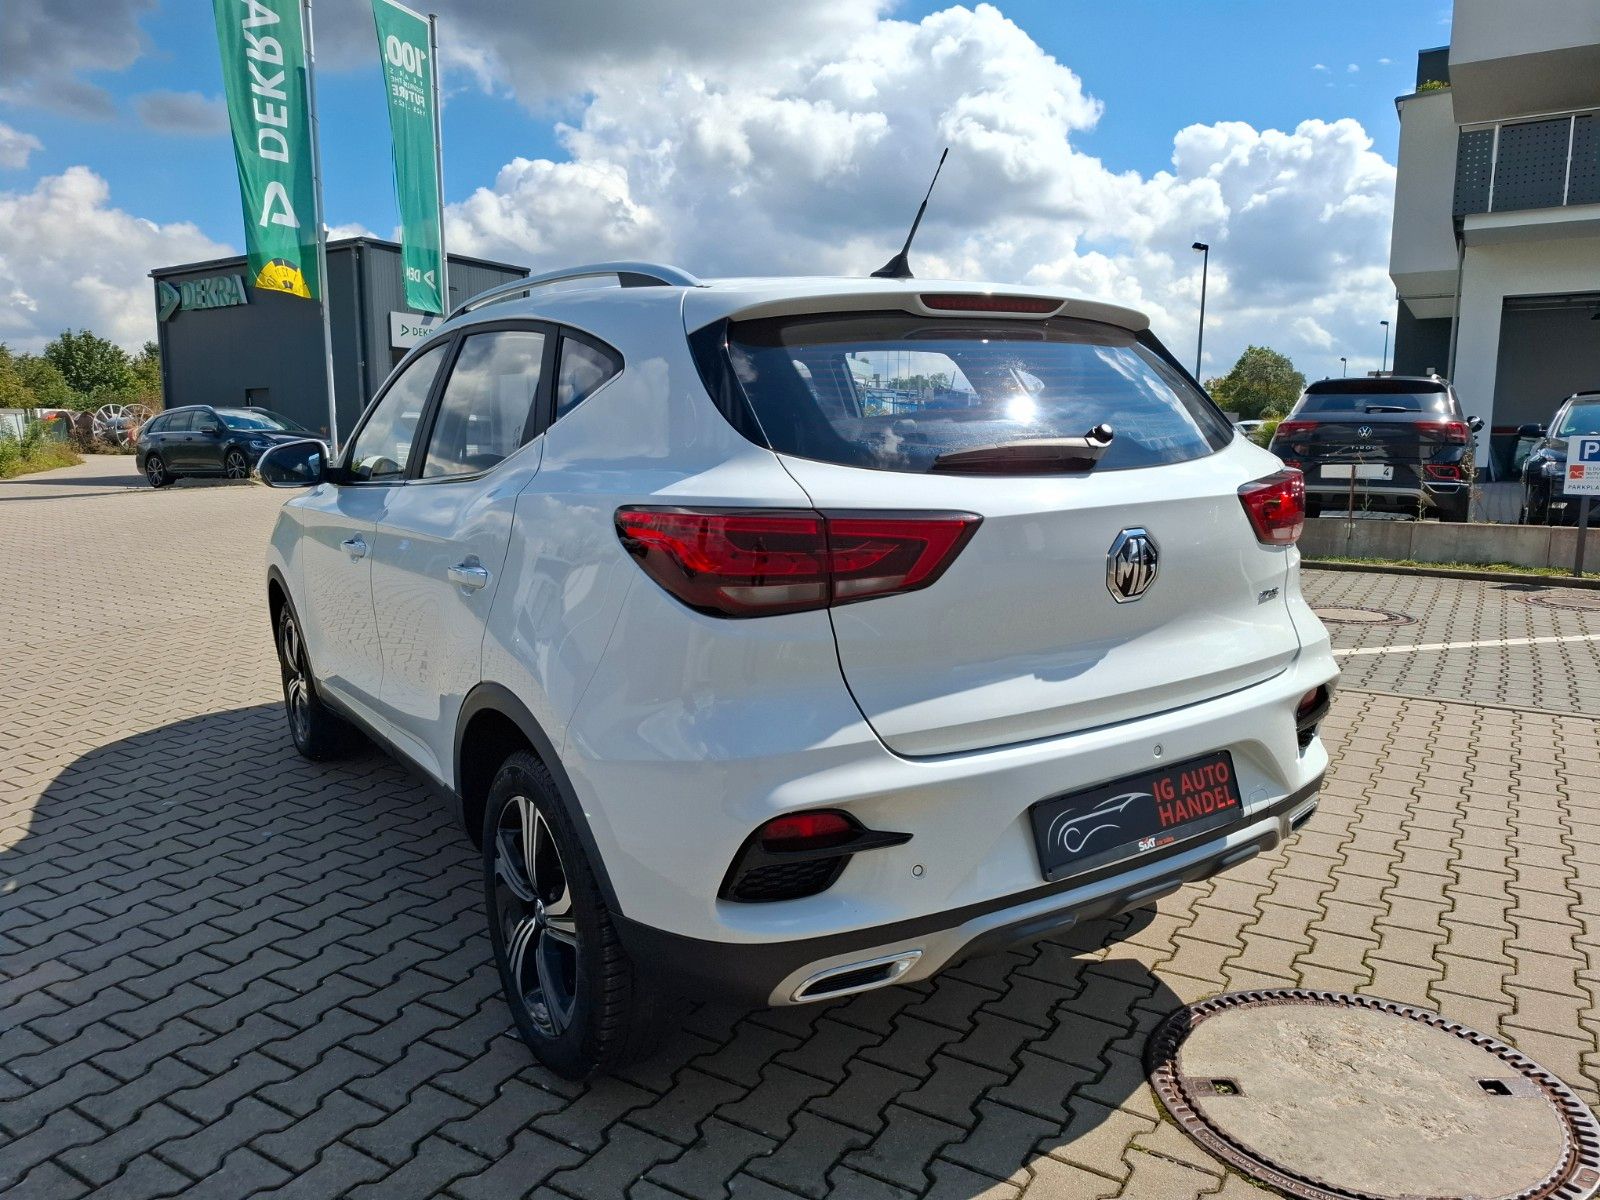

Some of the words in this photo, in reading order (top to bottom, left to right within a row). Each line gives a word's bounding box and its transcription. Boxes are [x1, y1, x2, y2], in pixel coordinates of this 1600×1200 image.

[180, 274, 248, 311] DEKRA
[1583, 441, 1600, 460] P
[1152, 777, 1175, 803] IG
[1181, 761, 1230, 796] AUTO
[1158, 784, 1238, 827] HANDEL
